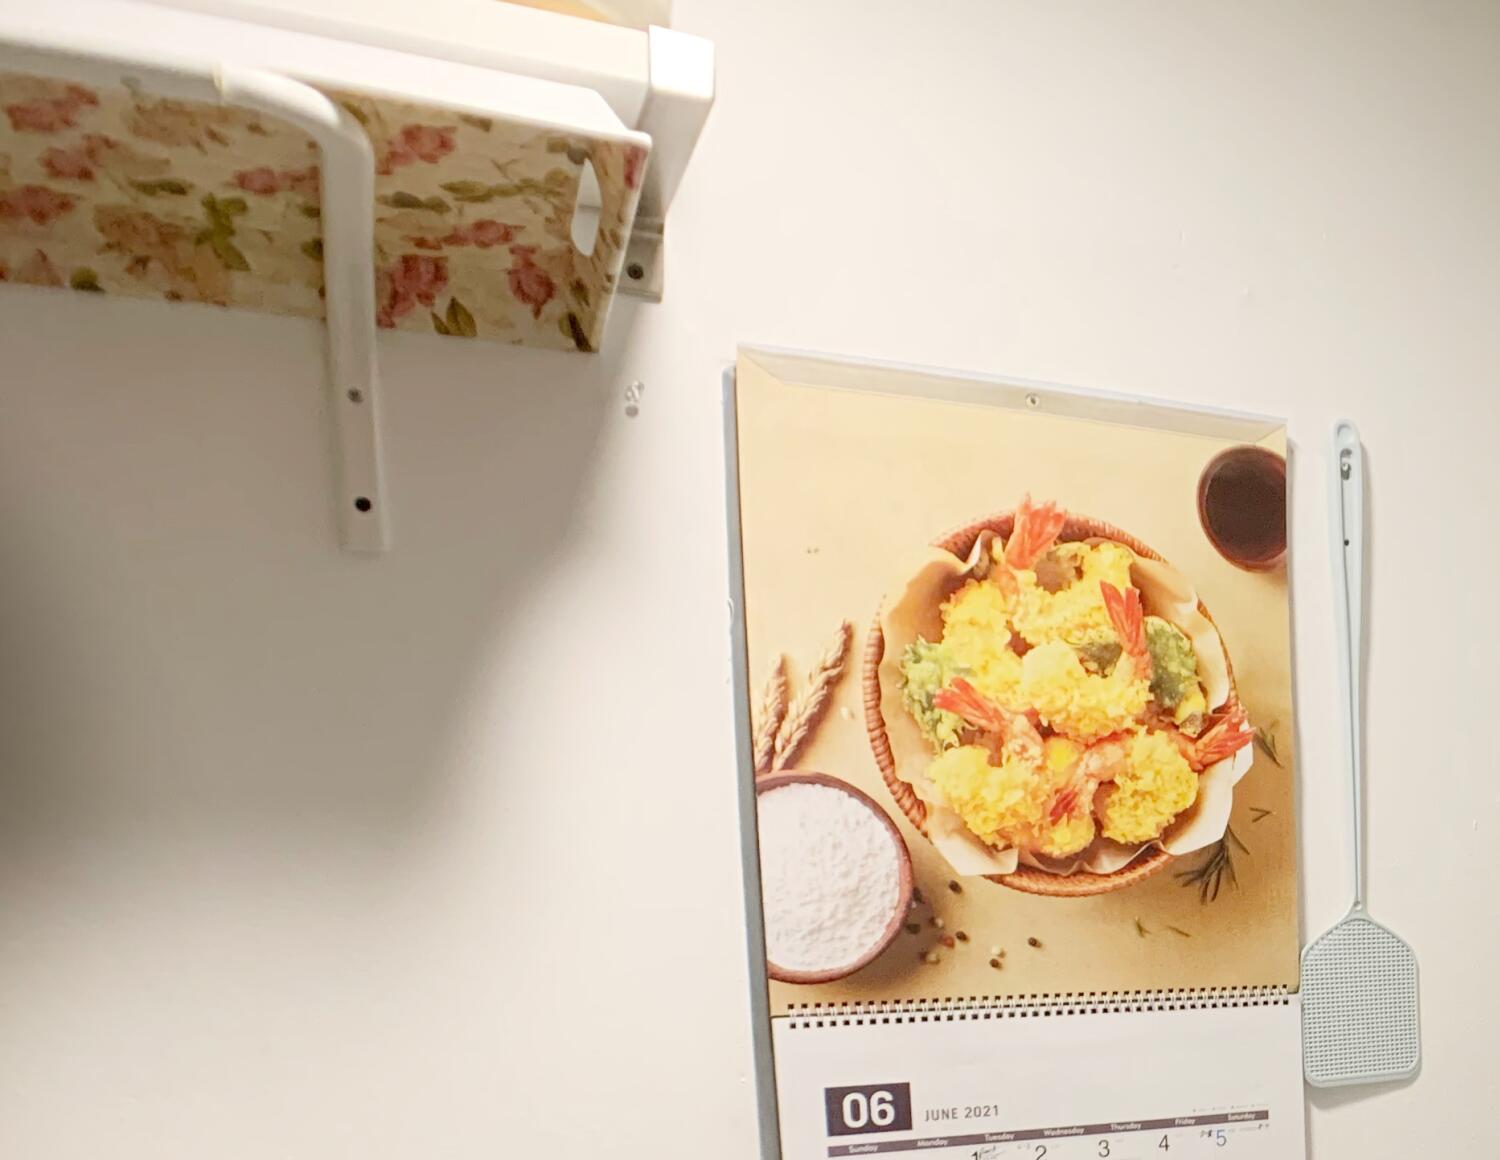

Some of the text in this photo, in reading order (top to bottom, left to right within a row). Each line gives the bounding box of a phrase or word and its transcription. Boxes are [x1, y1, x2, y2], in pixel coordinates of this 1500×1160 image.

[842, 1090, 896, 1128] 06
[924, 1104, 1000, 1122] JUNE 2021
[848, 1112, 1256, 1154] Sunday Monday Tuesday Wednesday Thursday Friday Saturday
[1099, 1140, 1110, 1157] 3
[1159, 1135, 1169, 1151] 4
[1217, 1129, 1227, 1147] 5
